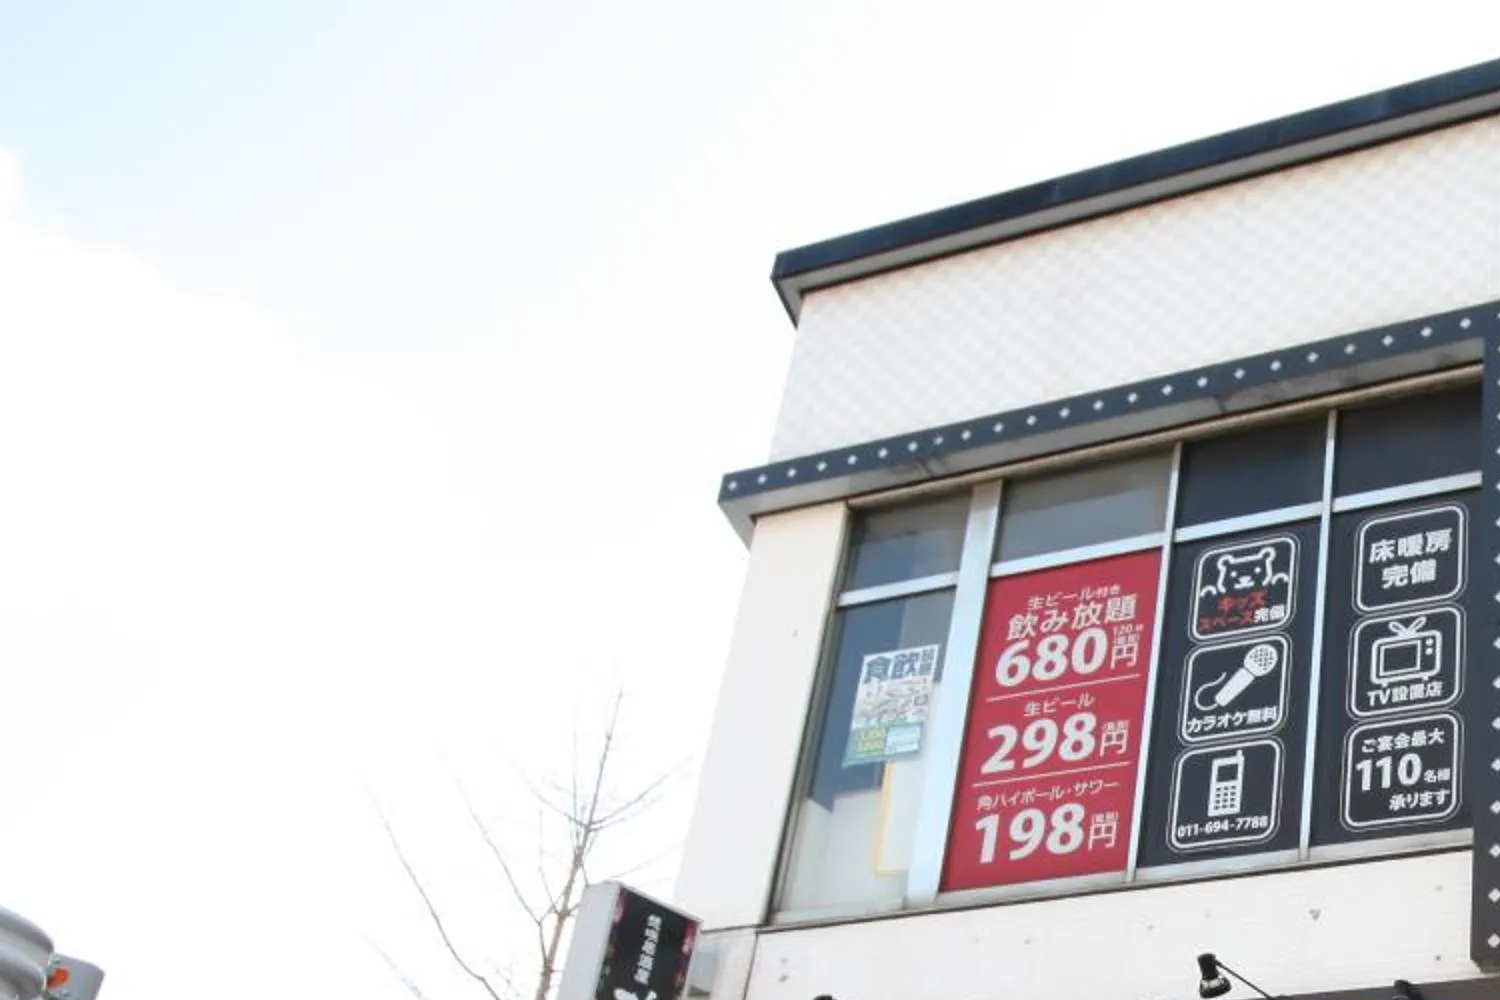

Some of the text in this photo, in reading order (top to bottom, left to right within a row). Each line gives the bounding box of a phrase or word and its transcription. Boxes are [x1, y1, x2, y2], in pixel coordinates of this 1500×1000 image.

[1369, 527, 1453, 563] 床暖房
[1381, 558, 1437, 589] 完備
[1007, 593, 1137, 641] 飲み放題
[1024, 693, 1095, 717] 生ビール
[1367, 680, 1444, 707] TV設置店
[1187, 705, 1279, 734] カラオケ無料
[1388, 788, 1451, 811] 承ります
